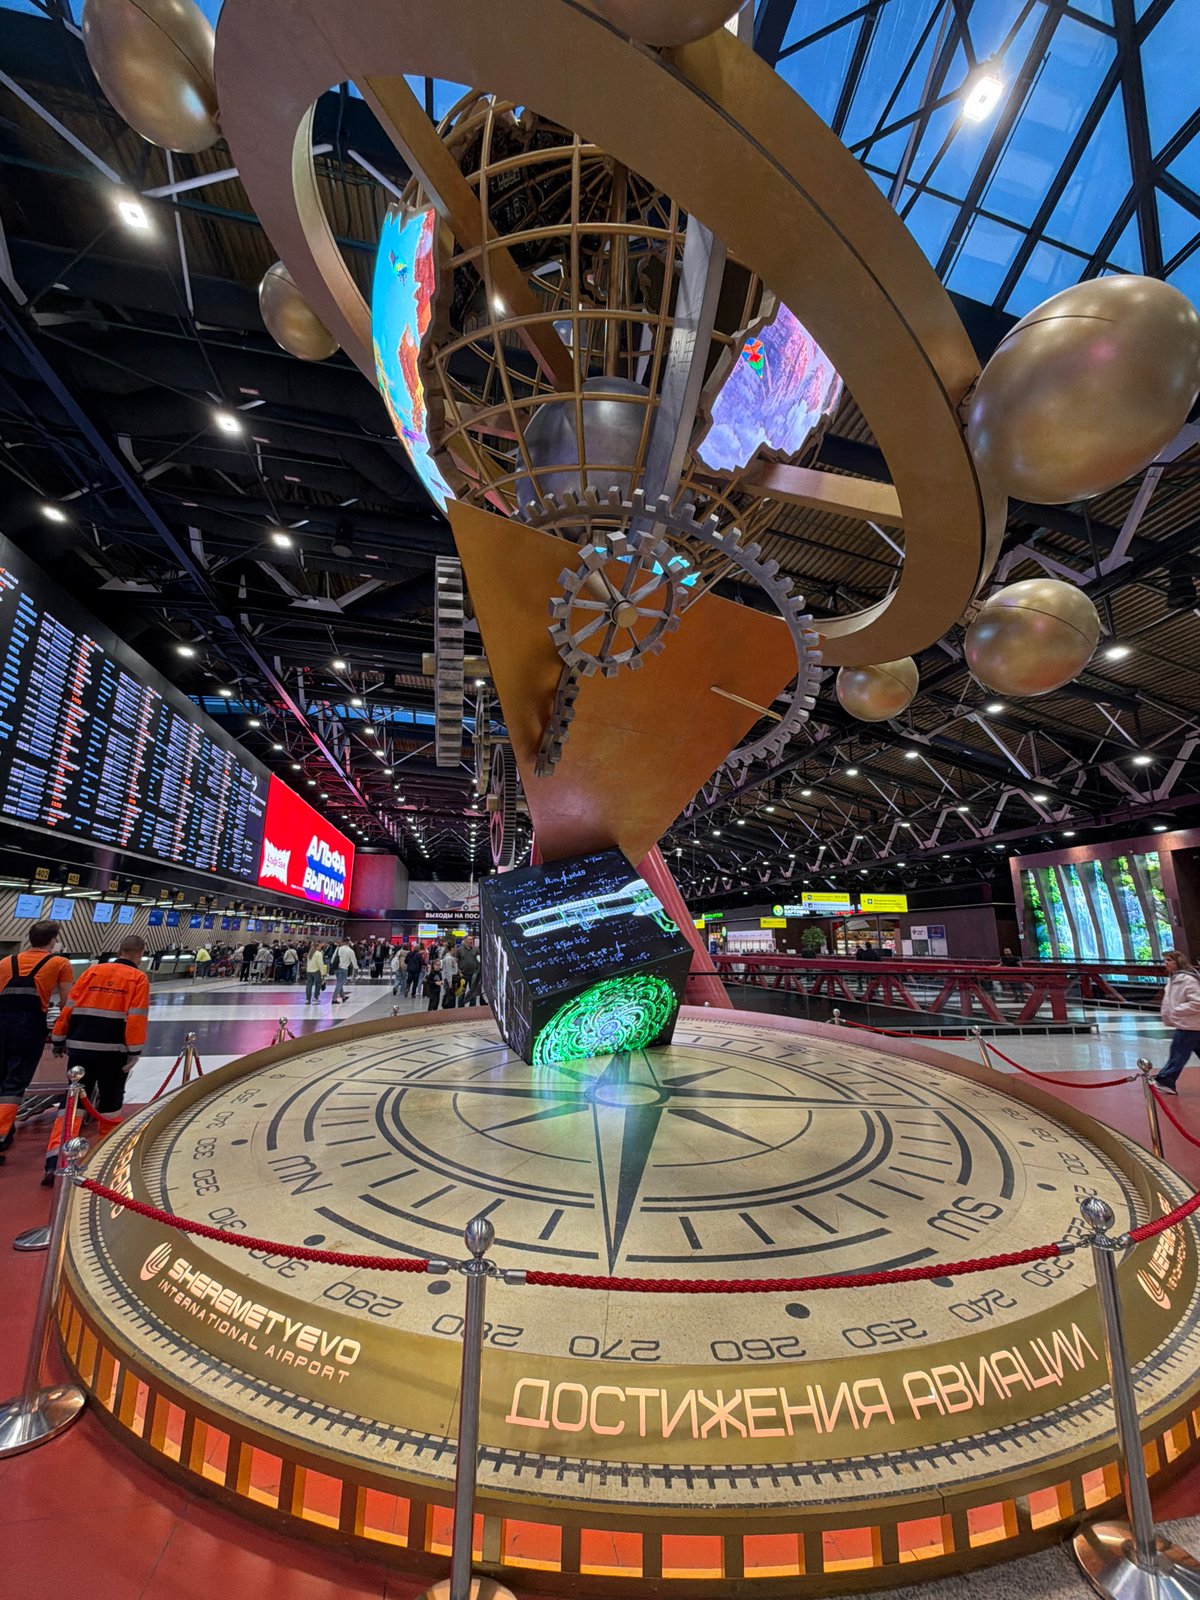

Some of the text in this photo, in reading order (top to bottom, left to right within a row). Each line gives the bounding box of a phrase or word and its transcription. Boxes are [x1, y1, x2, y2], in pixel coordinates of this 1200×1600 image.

[307, 835, 346, 876] АЛЬФА
[303, 867, 345, 902] ВЫГОДНО
[206, 1111, 235, 1130] 340
[193, 1137, 217, 1160] 330
[1058, 1151, 1090, 1176] 200
[192, 1169, 220, 1197] 320
[267, 1154, 333, 1195] NW
[927, 1196, 1003, 1242] SW
[168, 1257, 361, 1365] SHEREMETYEVO
[323, 1281, 403, 1317] 290
[948, 1288, 1018, 1323] 240
[158, 1278, 350, 1384] INTERNATIONAL AIRPORT
[569, 1335, 662, 1362] 270
[842, 1317, 928, 1349] 250
[710, 1336, 807, 1362] 260
[505, 1322, 1099, 1439] ДОСТИЖЕНИЯ АВИАЦИИ
